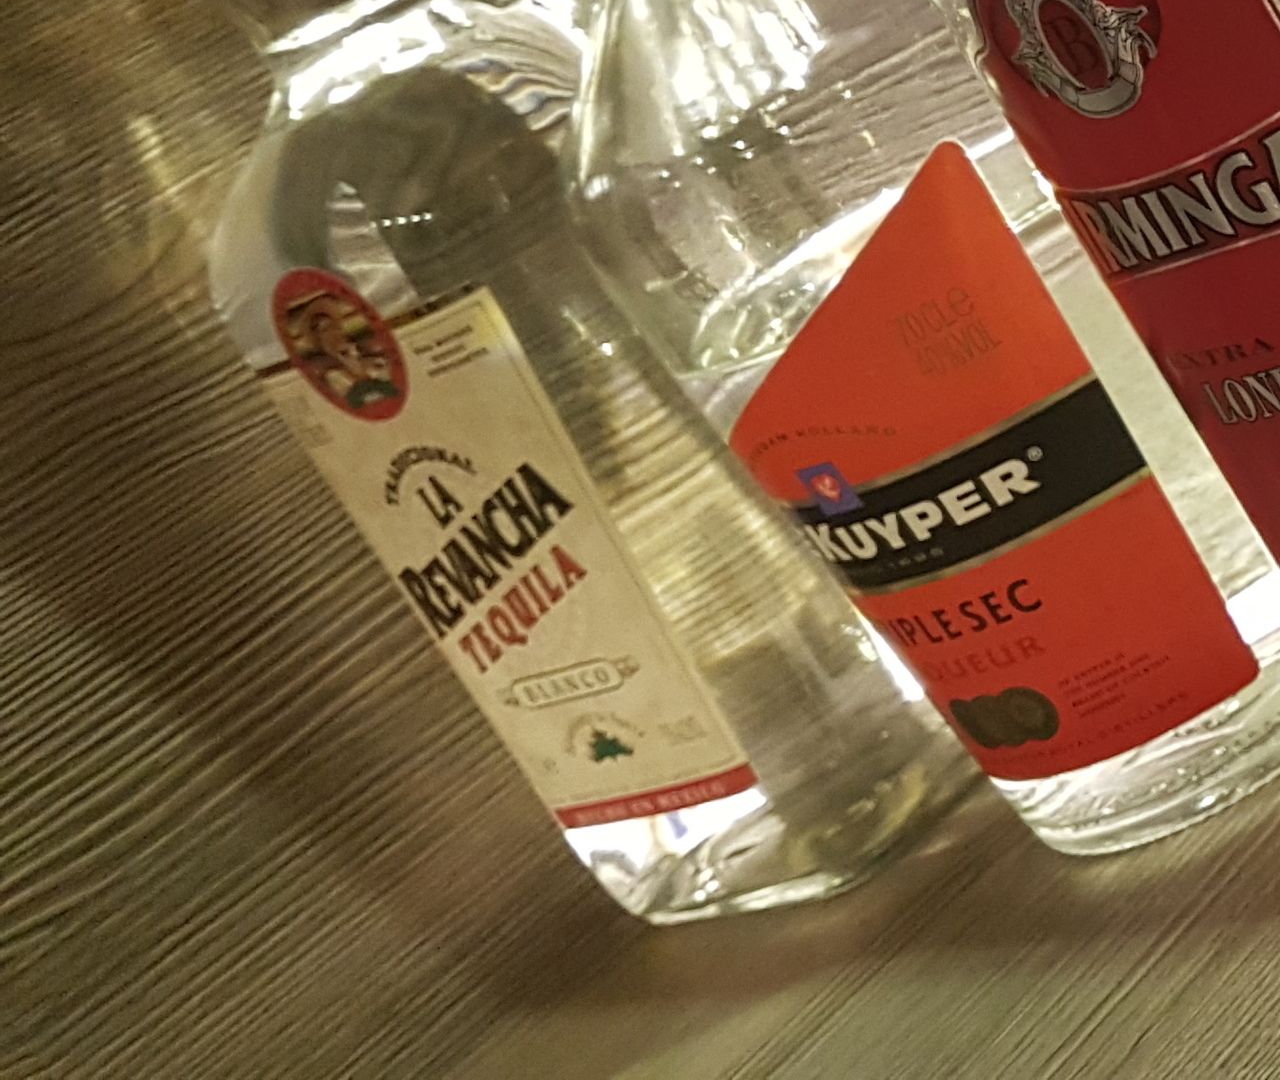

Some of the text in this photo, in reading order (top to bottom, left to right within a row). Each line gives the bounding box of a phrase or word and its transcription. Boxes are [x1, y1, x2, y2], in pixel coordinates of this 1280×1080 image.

[416, 474, 465, 530] LA
[398, 461, 576, 640] REVANCHA
[457, 542, 589, 675] TEQUILA
[958, 577, 1044, 634] SEC
